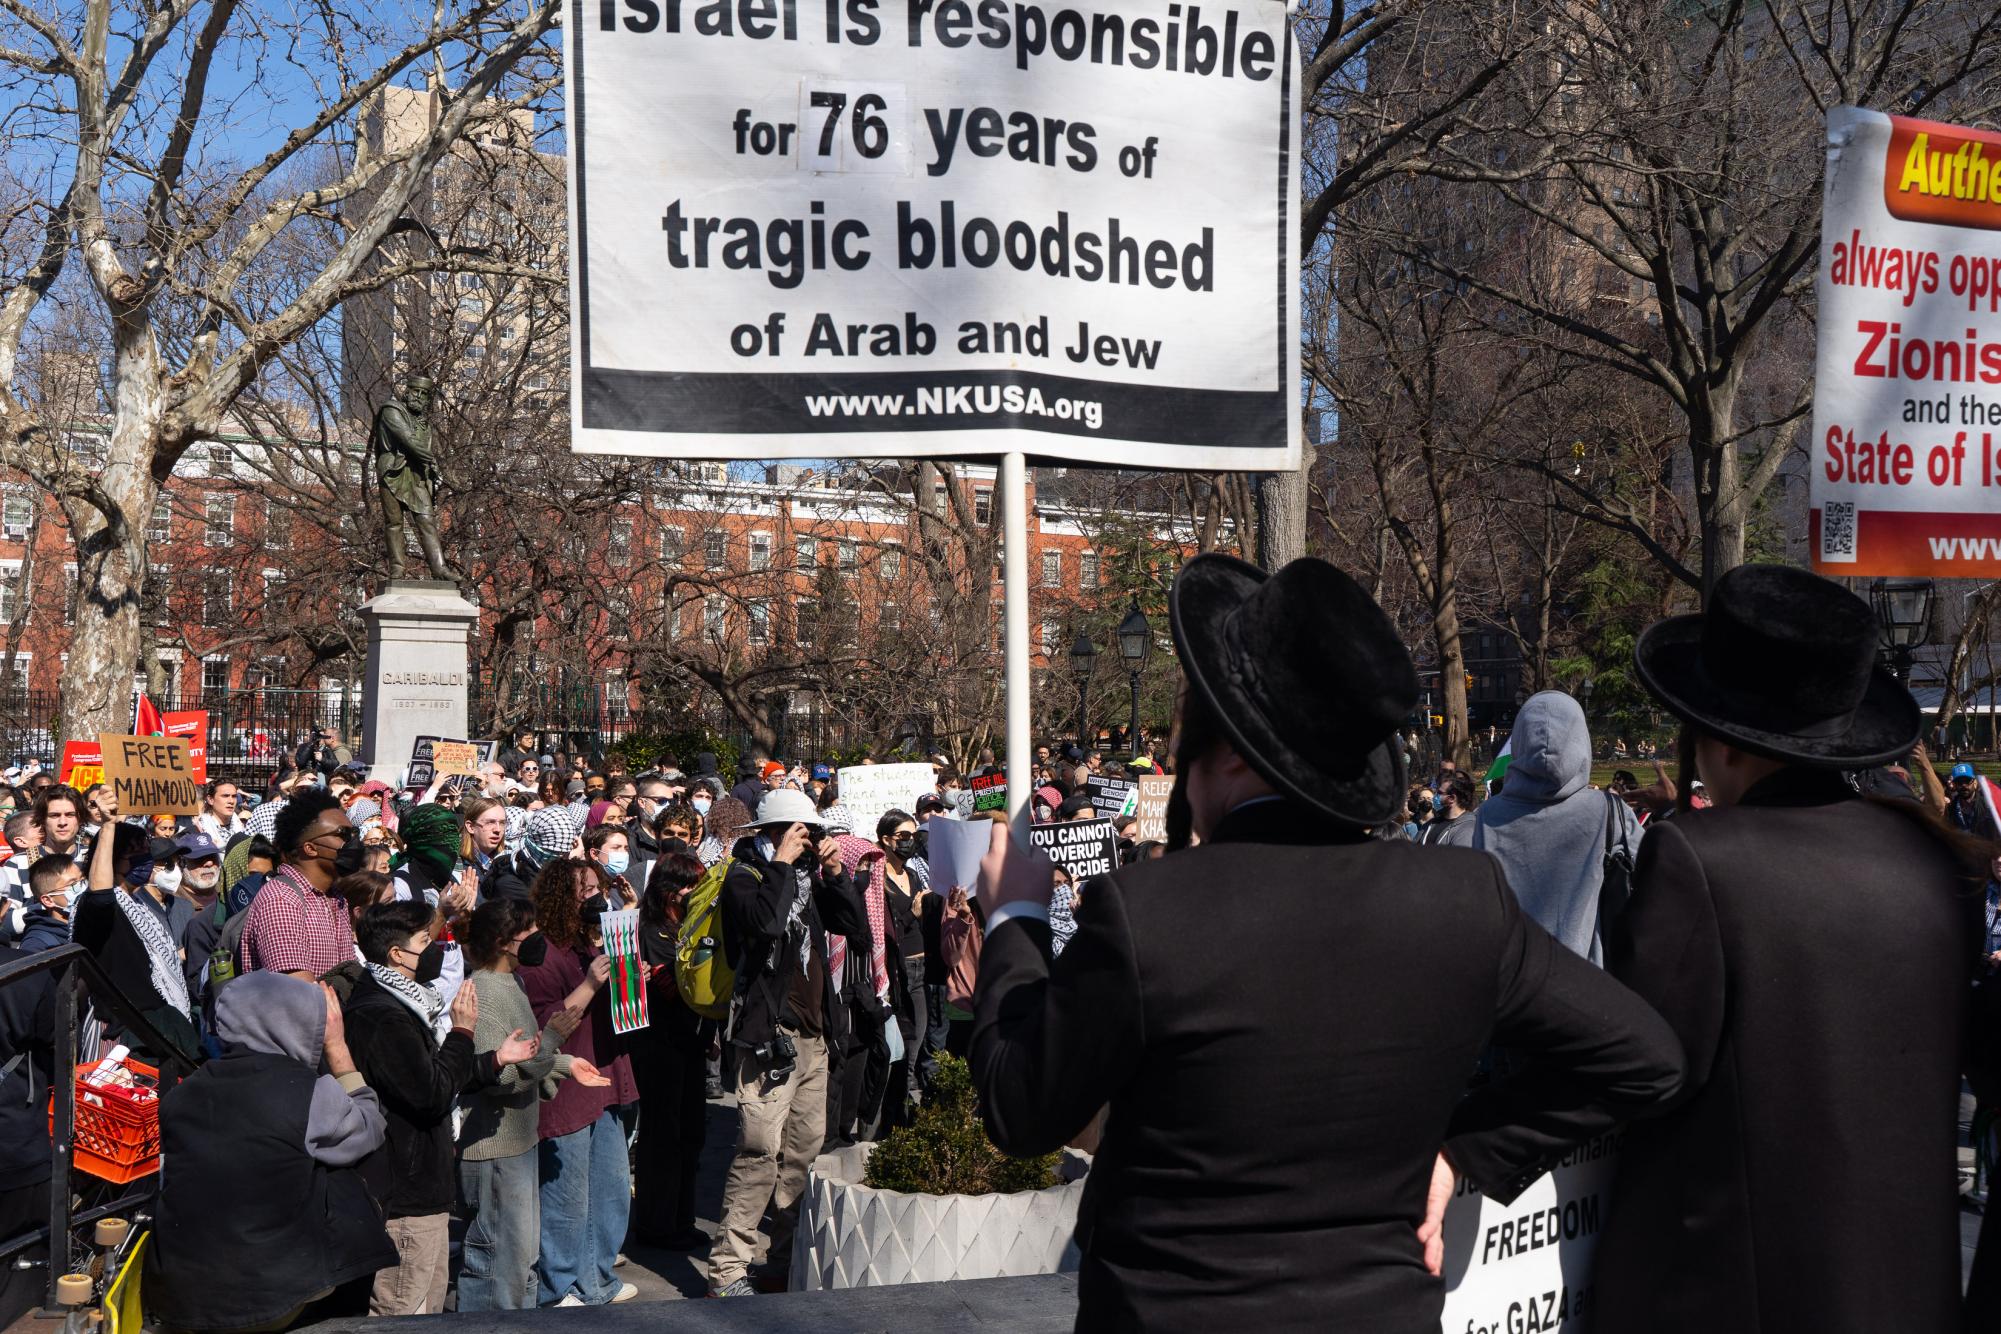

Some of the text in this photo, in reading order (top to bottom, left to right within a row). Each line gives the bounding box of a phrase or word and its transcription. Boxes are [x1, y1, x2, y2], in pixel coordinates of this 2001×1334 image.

[826, 0, 881, 45] is
[907, 0, 1275, 82] responsible
[733, 91, 1158, 178] for 76 years of
[662, 198, 1213, 292] tragic bloodshed
[1830, 229, 1940, 308] always
[730, 312, 1162, 370] of Arab and Jew
[1854, 320, 2001, 384] Zionis
[805, 386, 1103, 429] www.NKUSA.org
[1902, 393, 2001, 426] and the
[1824, 425, 2001, 487] State of I
[383, 672, 463, 686] GARIBALDI
[122, 741, 185, 771] FREE
[114, 777, 197, 807] MAHMOUD
[841, 771, 863, 784] The
[887, 785, 914, 798] with
[971, 775, 991, 790] FREE
[1089, 776, 1109, 786] WHEN
[1112, 780, 1122, 788] WE
[1093, 798, 1102, 806] WE
[1058, 822, 1111, 844] CANNOT
[1042, 841, 1103, 863] OVERUP
[1062, 857, 1111, 877] OCIDE
[1482, 1194, 1599, 1265] FREEDOM
[1507, 1285, 1569, 1334] GAZA
